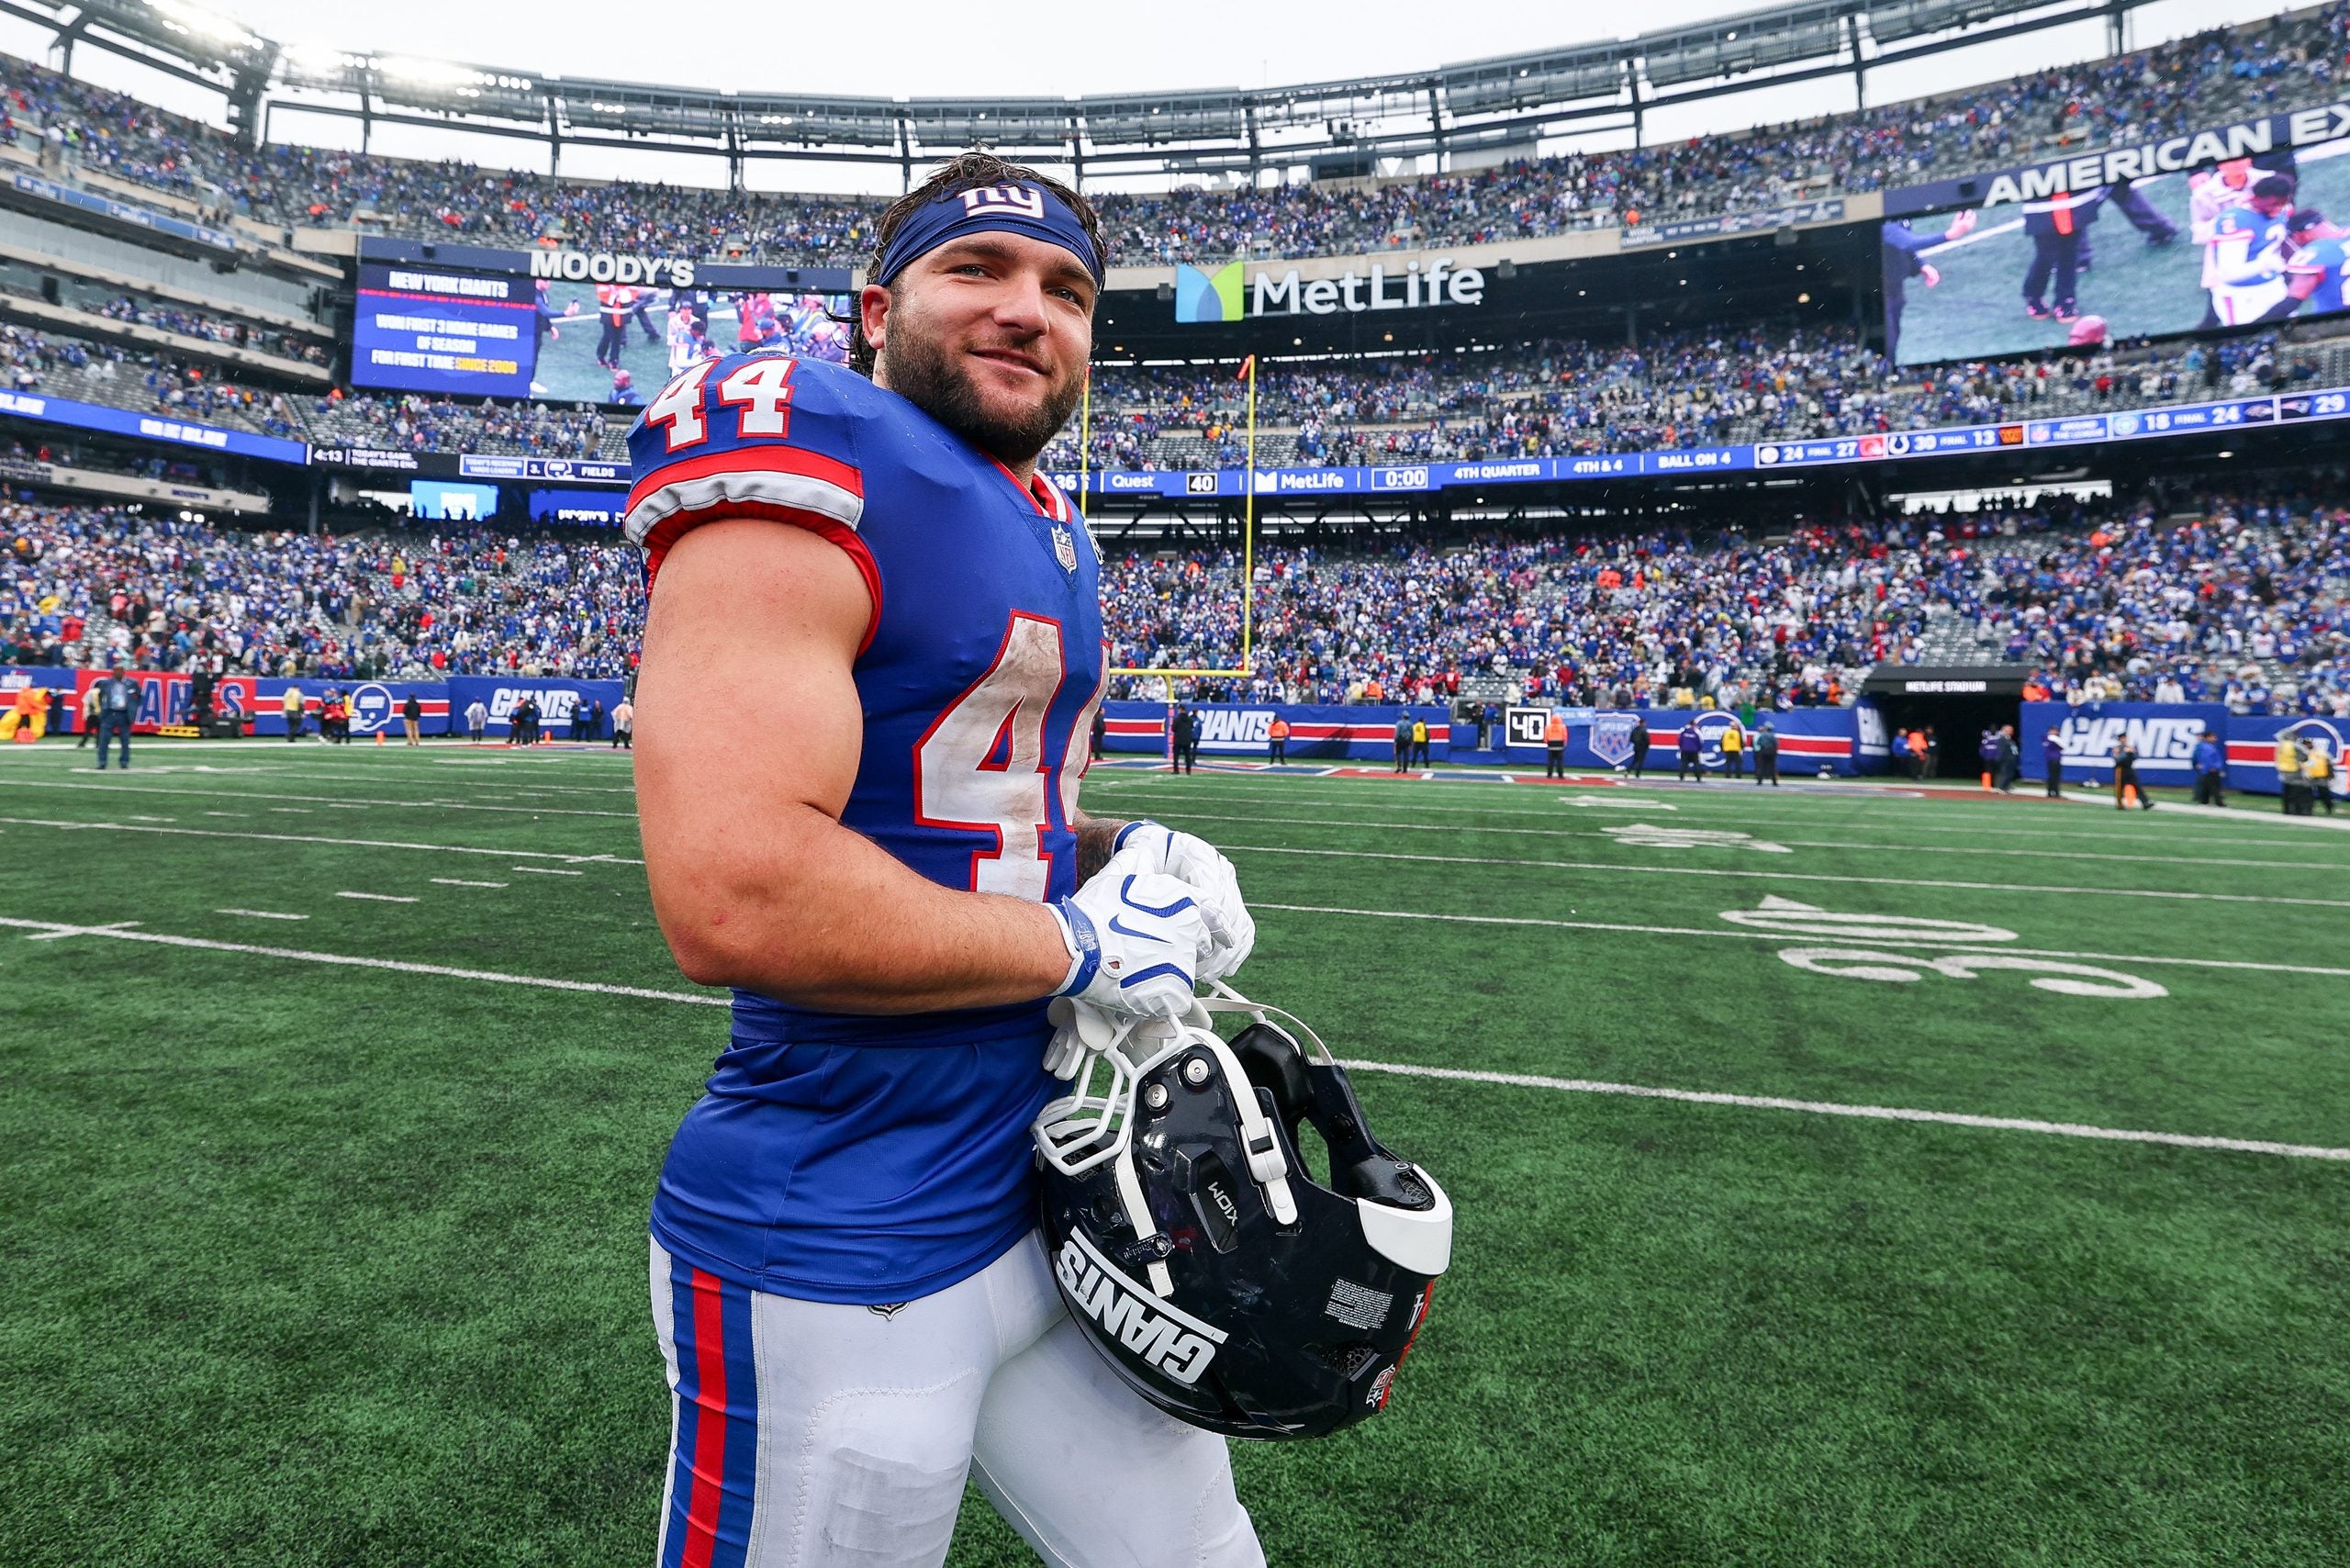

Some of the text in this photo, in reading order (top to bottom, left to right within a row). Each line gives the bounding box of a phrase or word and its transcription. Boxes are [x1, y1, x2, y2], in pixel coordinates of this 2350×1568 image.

[1983, 118, 2272, 208] AMERICAN
[530, 251, 695, 287] MOODY'S
[389, 271, 509, 298] NEW YORK GIANTS
[1252, 257, 1485, 318] MetLife
[645, 356, 799, 454] 44
[2144, 413, 2171, 431] 18
[2211, 406, 2241, 424] 24
[1914, 434, 1938, 452] 30
[1973, 431, 1997, 445] 13
[314, 449, 344, 463] 4:13
[1783, 445, 1805, 461] 24
[1836, 442, 1857, 457] 27
[1572, 460, 1624, 475] 4TH & 4
[1658, 452, 1731, 470] BALL ON 4
[581, 466, 616, 478] FIELDS
[1281, 472, 1345, 490] MetLife
[1385, 469, 1427, 487] 0:00
[1454, 463, 1541, 481] 4TH QUARTER
[1112, 475, 1154, 489] Quest
[1190, 475, 1214, 492] 40
[1512, 715, 1545, 740] 40
[1056, 1240, 1216, 1384] GIANTS
[1338, 1318, 1369, 1330] WARNING
